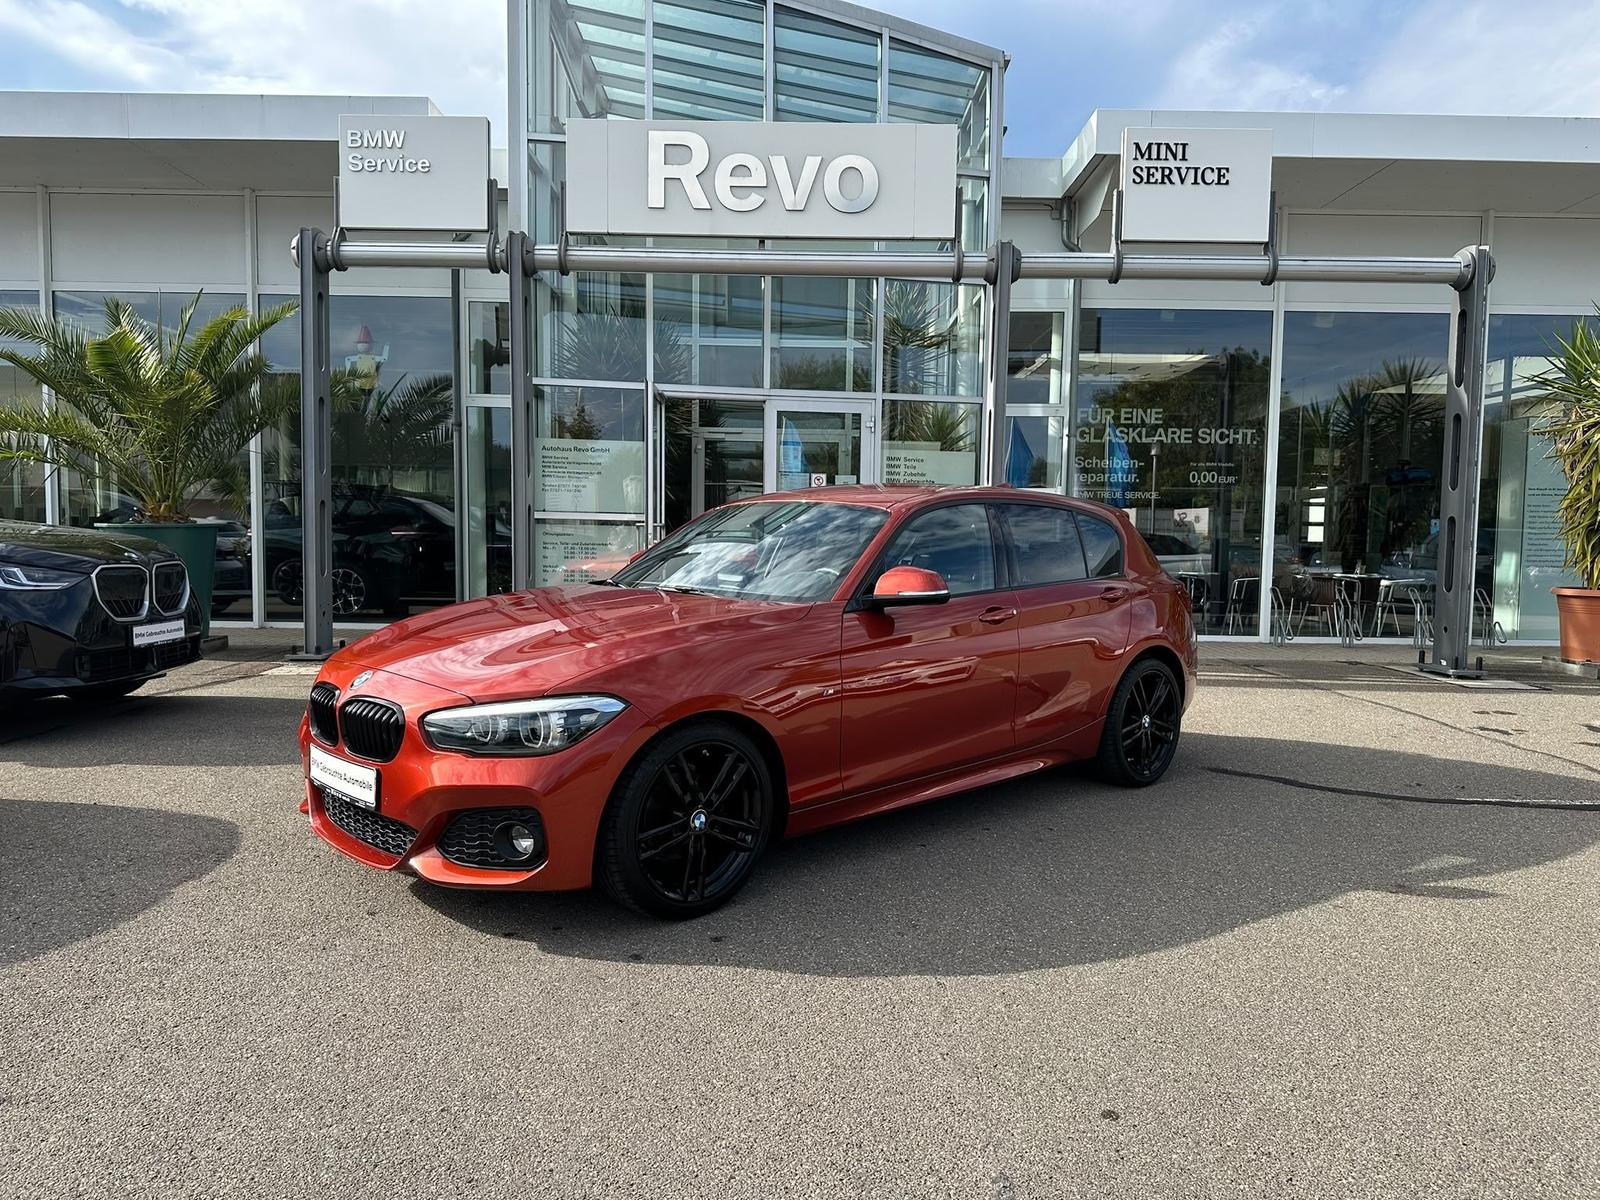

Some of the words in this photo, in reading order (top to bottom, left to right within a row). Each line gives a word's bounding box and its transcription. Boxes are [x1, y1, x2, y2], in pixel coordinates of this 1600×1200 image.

[346, 129, 406, 149] BMW
[1132, 141, 1189, 162] MINI
[347, 153, 432, 173] Service
[647, 130, 880, 214] Revo
[1132, 165, 1230, 186] SERVICE
[1076, 405, 1115, 424] FÜR
[1120, 408, 1163, 424] EINE
[1076, 427, 1193, 444] GLASKLARE
[1197, 428, 1257, 445] SICHT.
[541, 445, 573, 453] Autohaus
[590, 446, 611, 454] GmbH
[1074, 457, 1145, 469] Scheiben-
[1074, 472, 1140, 485] reparatur.
[1190, 471, 1218, 486] 0,00
[1097, 491, 1124, 499] TREUE
[1124, 491, 1161, 499] SERVICE.
[343, 772, 373, 791] Automobile
